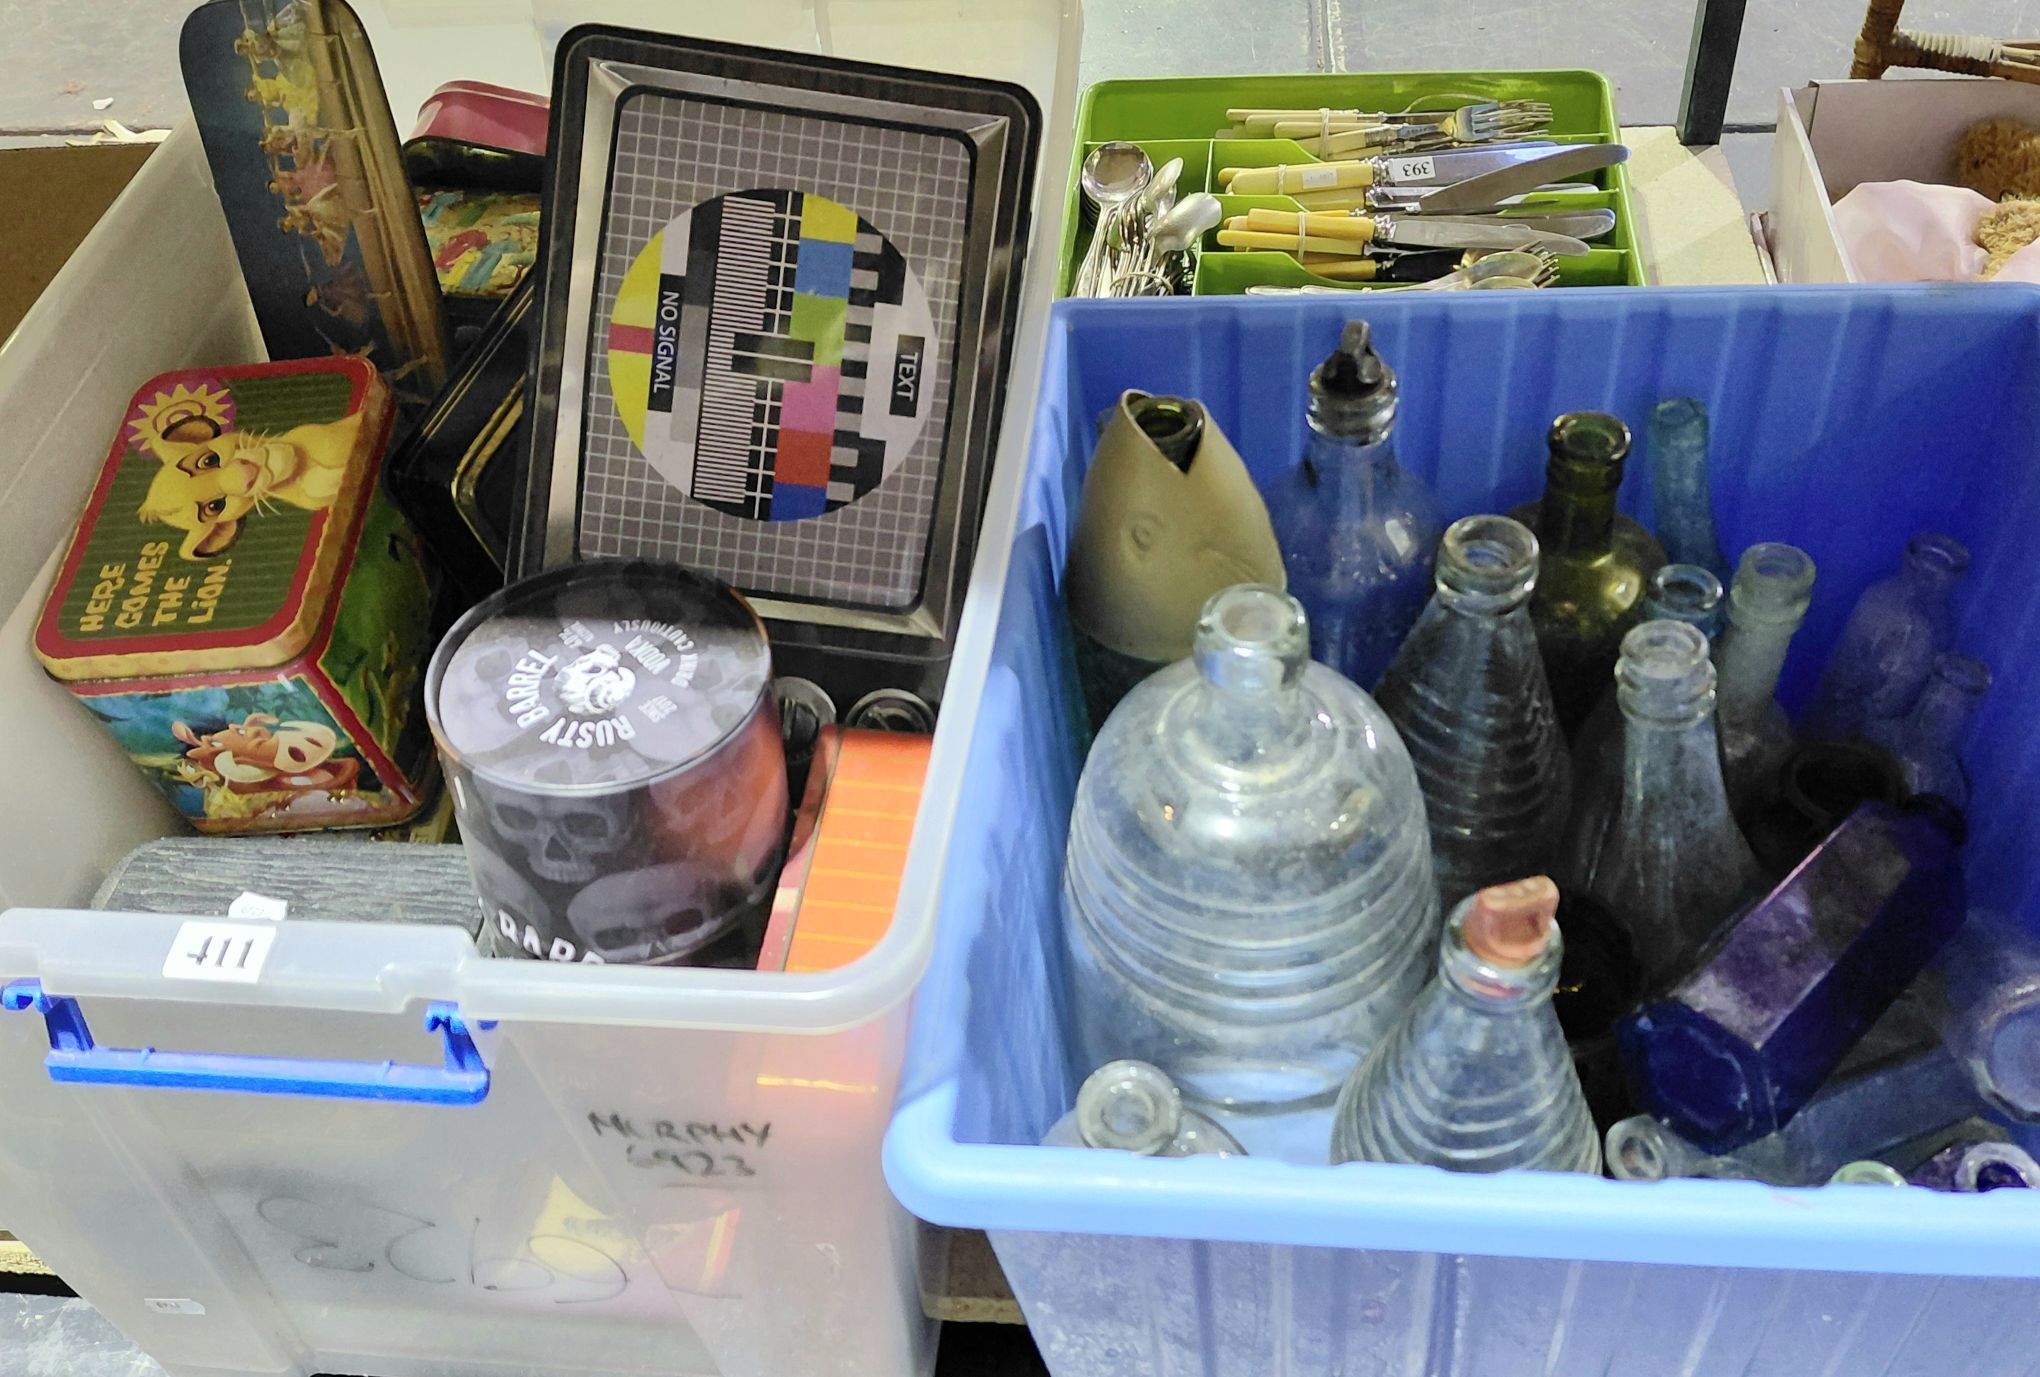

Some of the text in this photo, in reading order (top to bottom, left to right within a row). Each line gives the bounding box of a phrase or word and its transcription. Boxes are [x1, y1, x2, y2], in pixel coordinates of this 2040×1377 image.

[1402, 161, 1431, 178] 393
[653, 290, 681, 394] NO SIGNAL
[895, 351, 919, 402] TEXT
[79, 563, 126, 632] HERE
[114, 541, 169, 629] COMES
[152, 575, 191, 627] THE
[613, 619, 695, 652] CAUTIOUSLY
[624, 634, 672, 676] VODKA
[505, 649, 637, 749] RUSTY BARREL
[186, 935, 255, 969] 411
